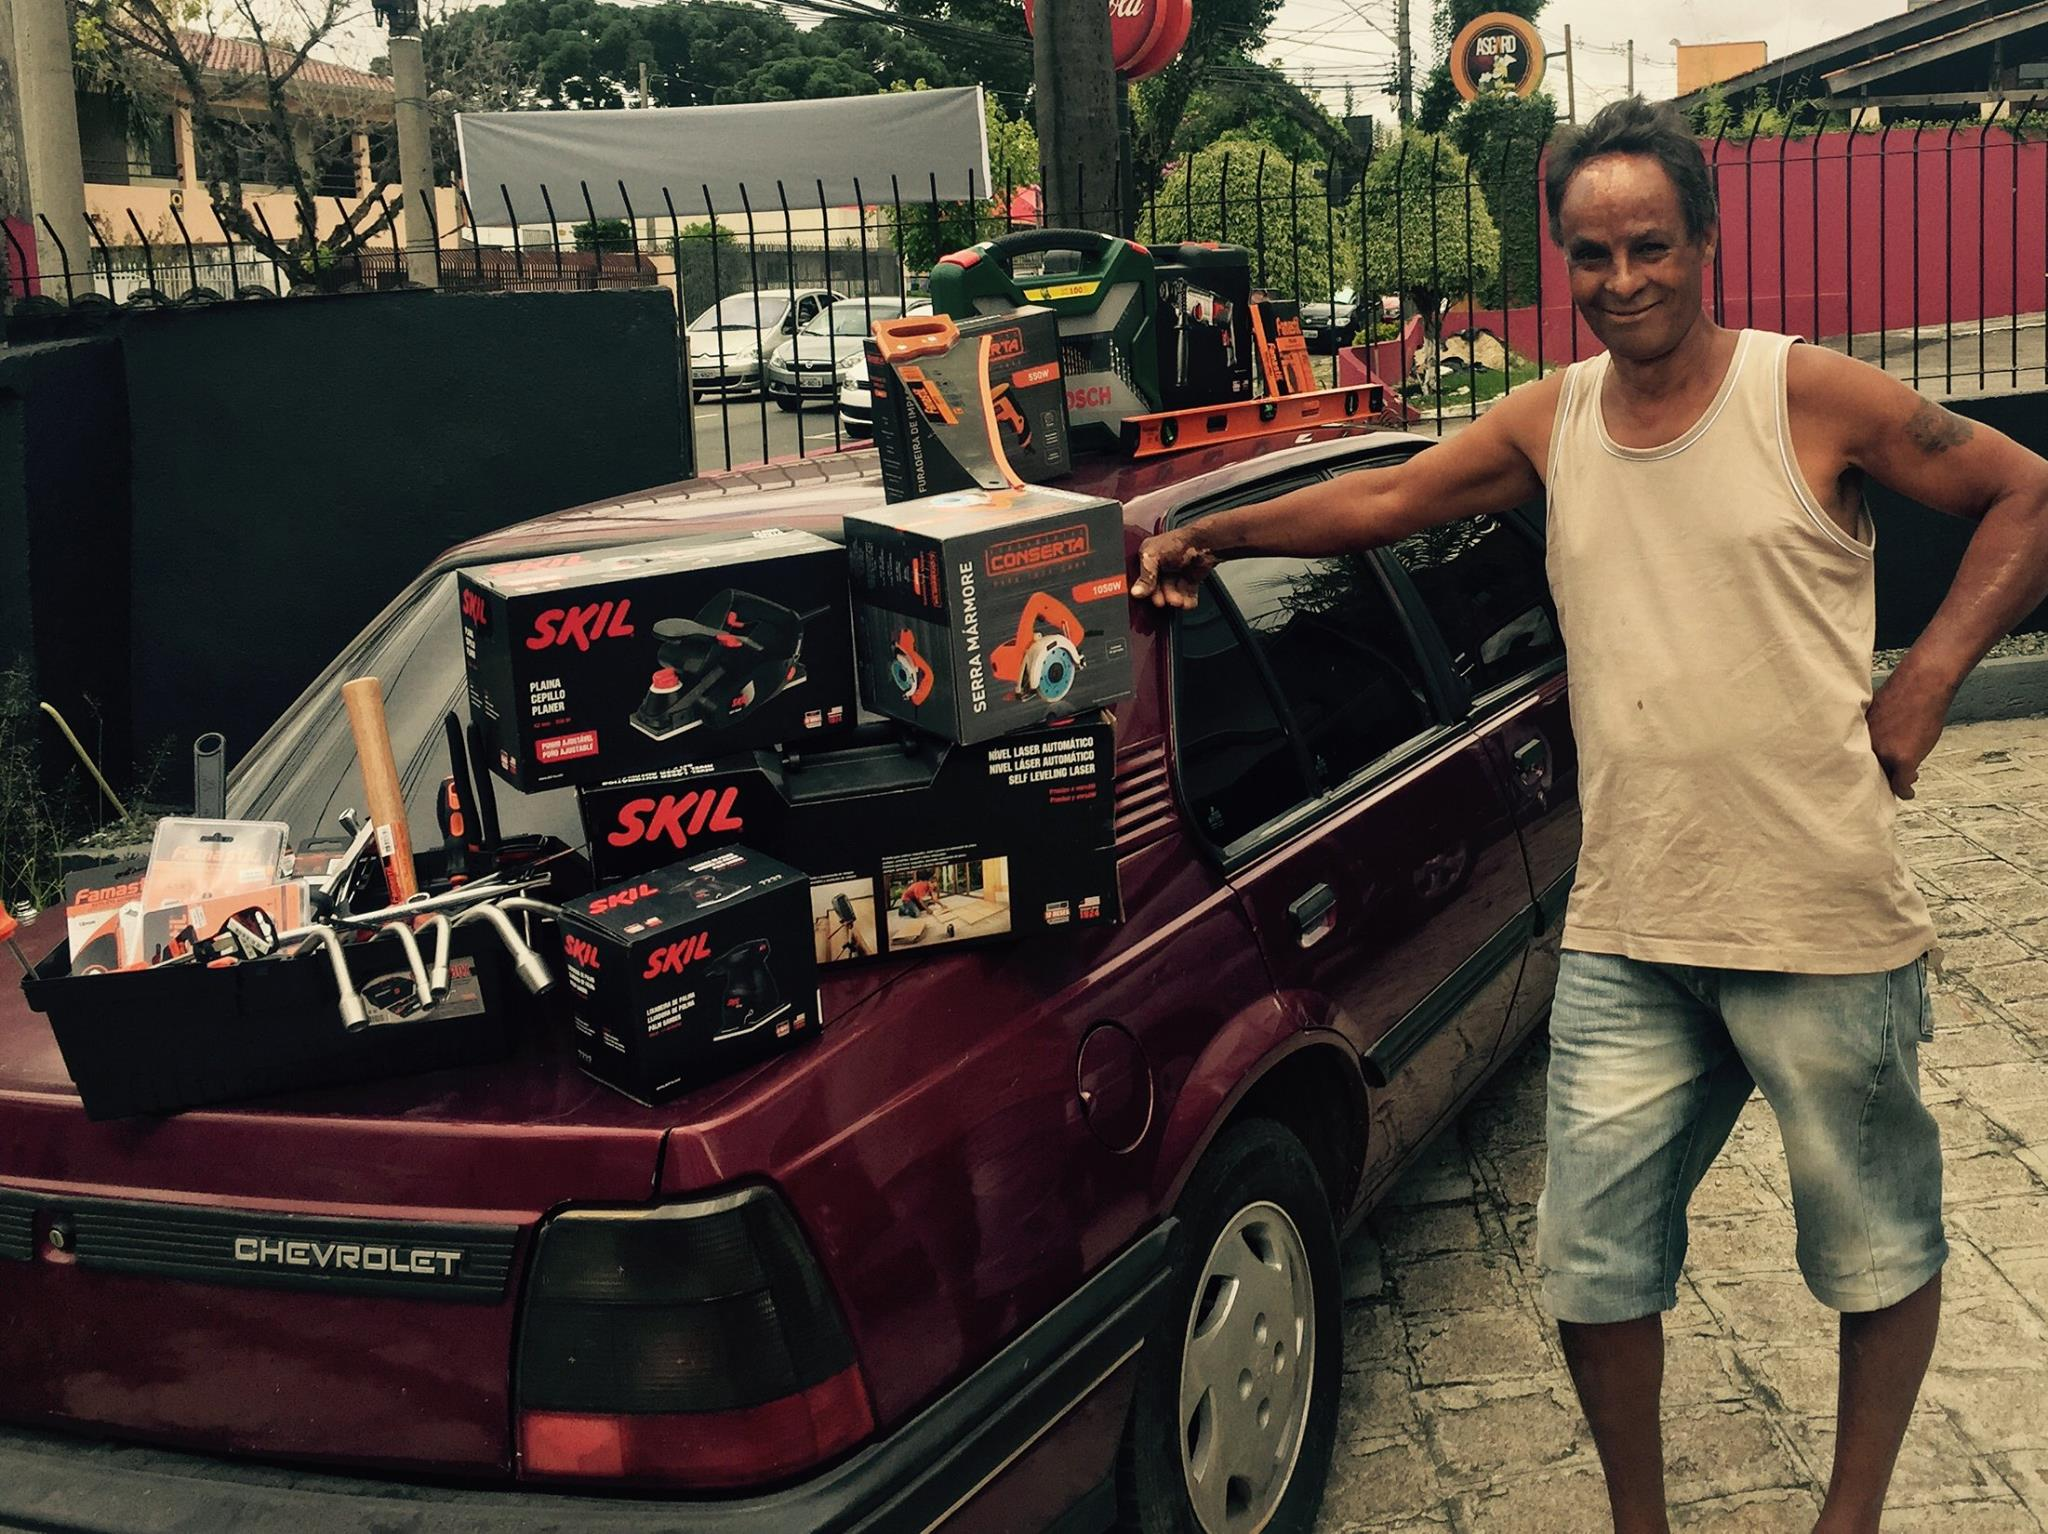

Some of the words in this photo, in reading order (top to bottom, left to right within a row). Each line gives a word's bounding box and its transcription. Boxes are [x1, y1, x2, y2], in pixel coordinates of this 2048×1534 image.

[1476, 35, 1516, 56] ASGARD
[1028, 369, 1049, 382] 550W
[910, 418, 919, 435] DE
[911, 435, 927, 493] FURADEIRA
[991, 536, 1084, 571] CONSERTA
[1092, 580, 1121, 595] 1050W
[462, 588, 487, 625] SKIL
[959, 561, 980, 651] MÁRMORE
[526, 599, 635, 652] SKIL
[529, 678, 562, 692] PLAINA
[530, 689, 566, 704] CEPILLO
[968, 654, 987, 713] SERRA
[531, 701, 566, 716] PLANER
[989, 762, 1013, 775] NIVEL
[1042, 749, 1095, 767] AUTOMÁTICO
[1013, 744, 1040, 758] LASER
[1041, 736, 1094, 753] AUTOMÁTICO
[1008, 772, 1028, 785] SELF
[1030, 767, 1067, 782] LEVELING
[1069, 763, 1096, 777] LASER
[607, 786, 743, 849] SKIL
[588, 883, 659, 916] SKIL
[564, 934, 600, 969] SKIL
[642, 931, 712, 979] SKIL
[235, 1238, 461, 1275] CHEVROLET
